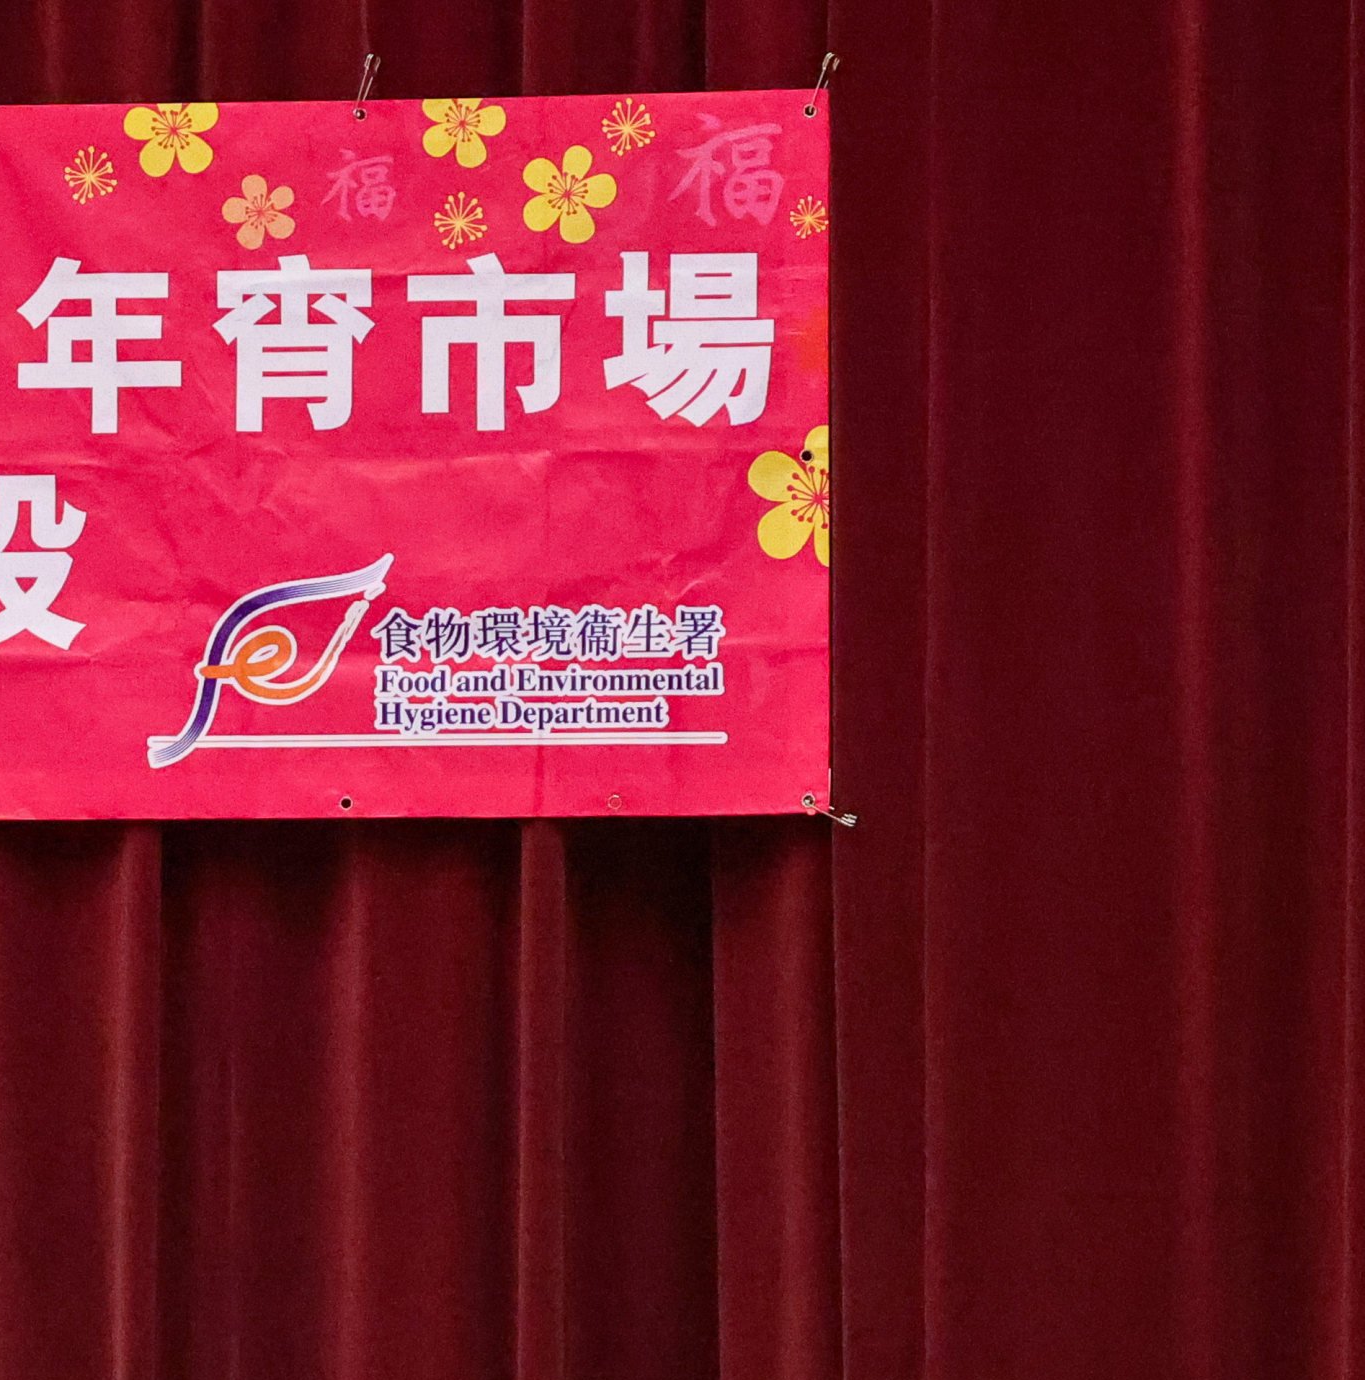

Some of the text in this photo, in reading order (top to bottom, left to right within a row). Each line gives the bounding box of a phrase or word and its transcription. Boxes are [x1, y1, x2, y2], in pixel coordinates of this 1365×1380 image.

[320, 149, 396, 222] 福
[670, 113, 785, 227] 福
[380, 667, 720, 693] Food and Environmental
[380, 699, 664, 730] Hygiene Department
